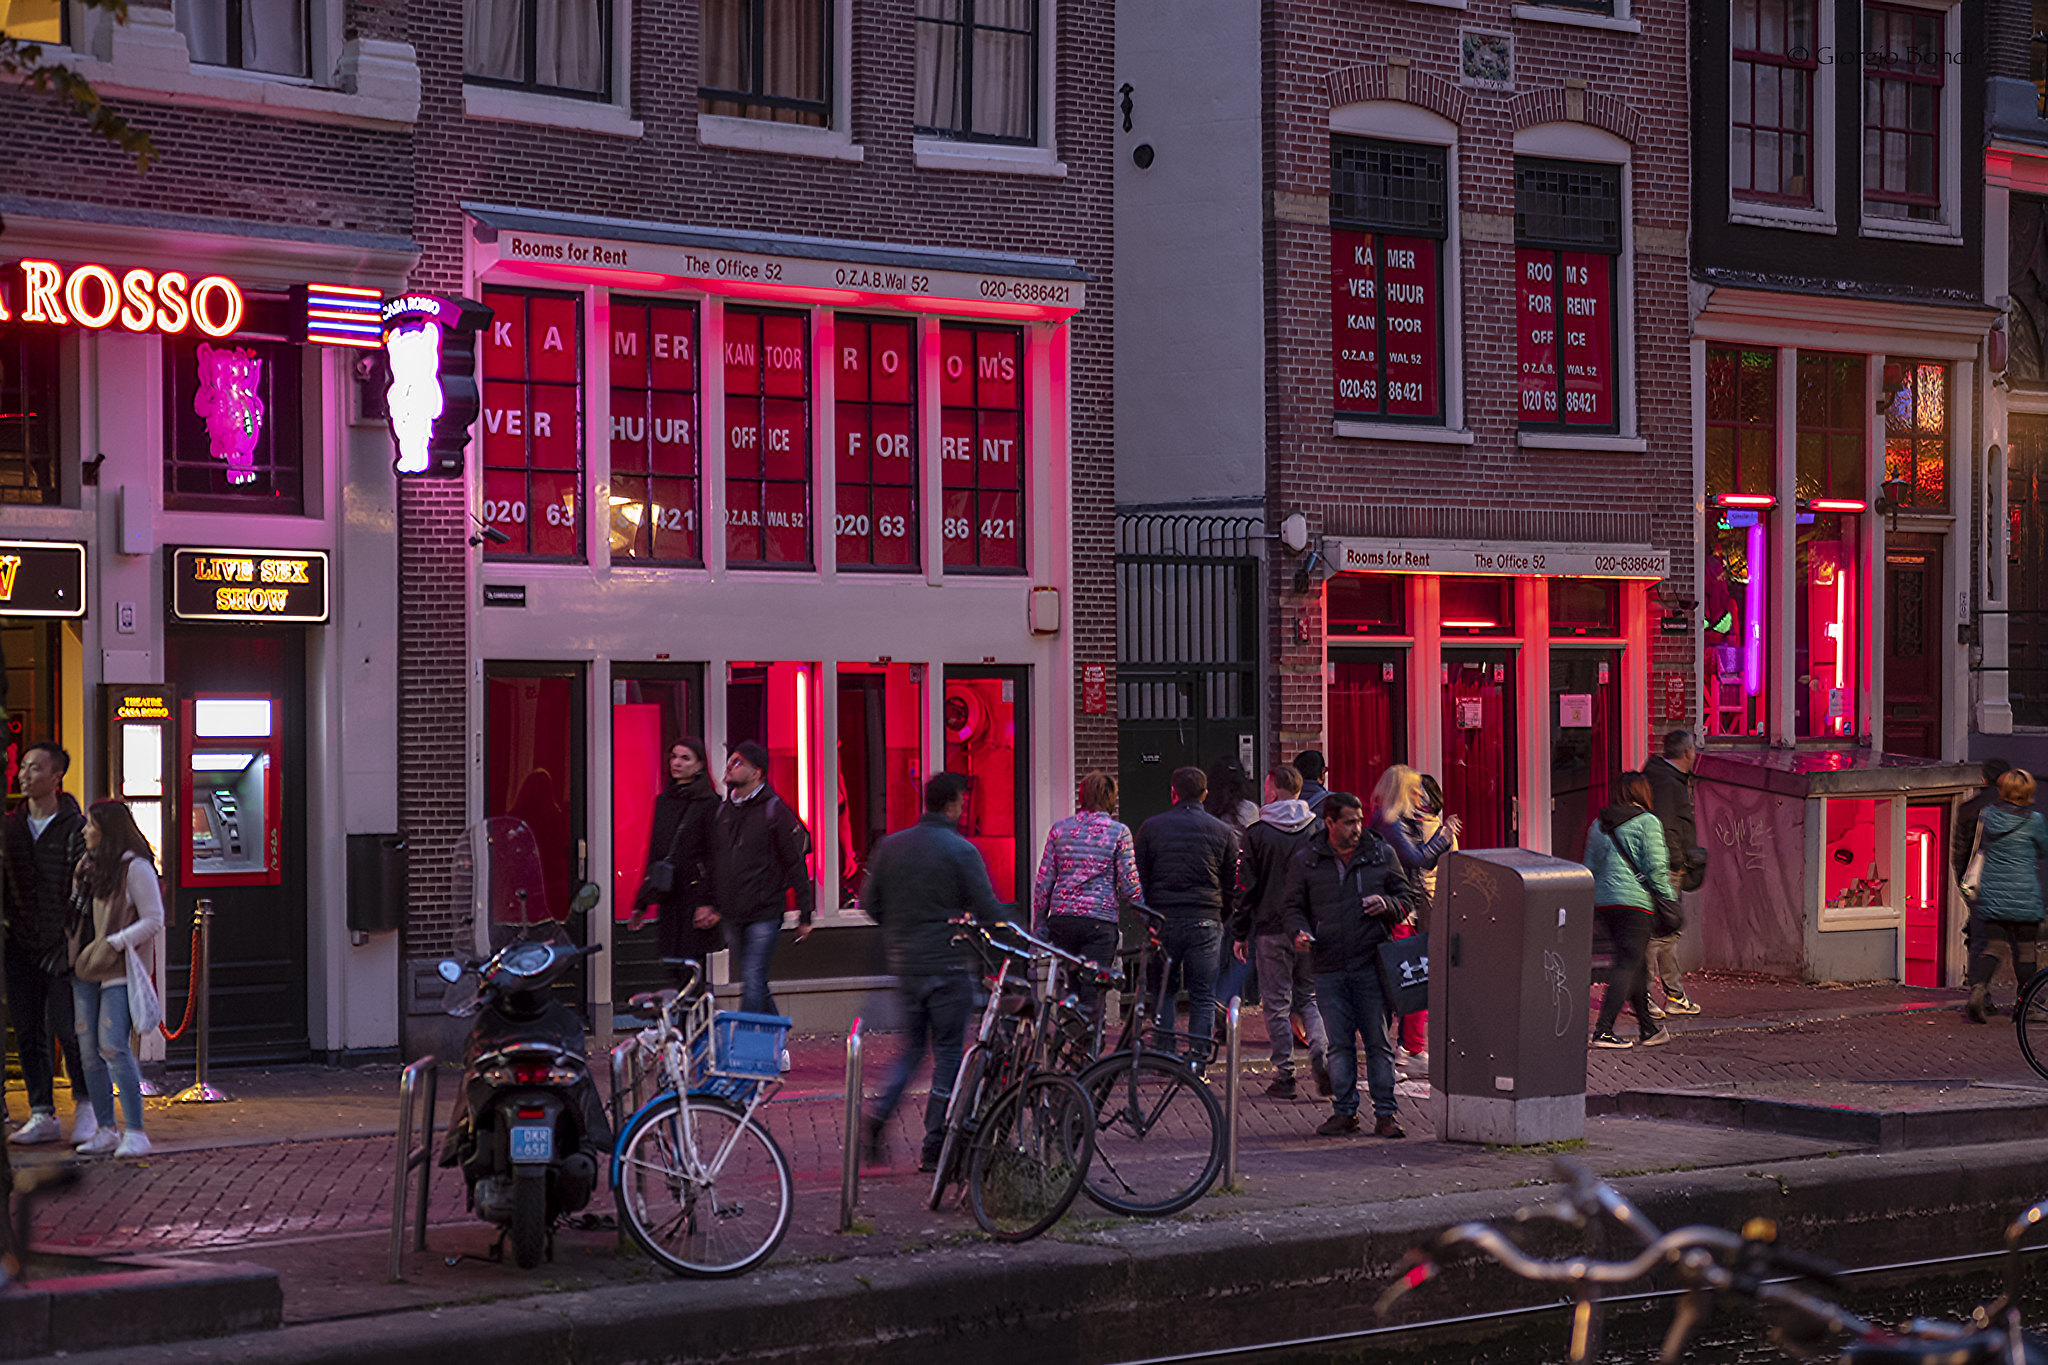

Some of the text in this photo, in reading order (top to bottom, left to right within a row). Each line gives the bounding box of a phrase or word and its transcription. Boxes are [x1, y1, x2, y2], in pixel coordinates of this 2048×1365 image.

[511, 237, 628, 266] Rooms for Rent
[684, 254, 783, 281] The Office 52
[911, 276, 929, 292] 52
[979, 279, 1071, 303] 020-6386421
[20, 257, 244, 337] ROSSO
[1528, 294, 1597, 317] FOR RENT
[1389, 352, 1409, 364] WAL
[1410, 353, 1422, 365] 52
[1566, 364, 1585, 376] WAL
[1586, 365, 1597, 377] 52
[483, 500, 526, 524] 020
[767, 511, 790, 528] WAL
[791, 512, 804, 528] 52
[835, 514, 1015, 540] 020 63 86 421
[1346, 548, 1430, 568] Rooms for Rent
[1474, 553, 1546, 570] The Office 52
[1594, 555, 1666, 572] 020-6386421
[194, 557, 309, 584] LIVE SEX
[215, 587, 289, 612] SHOW
